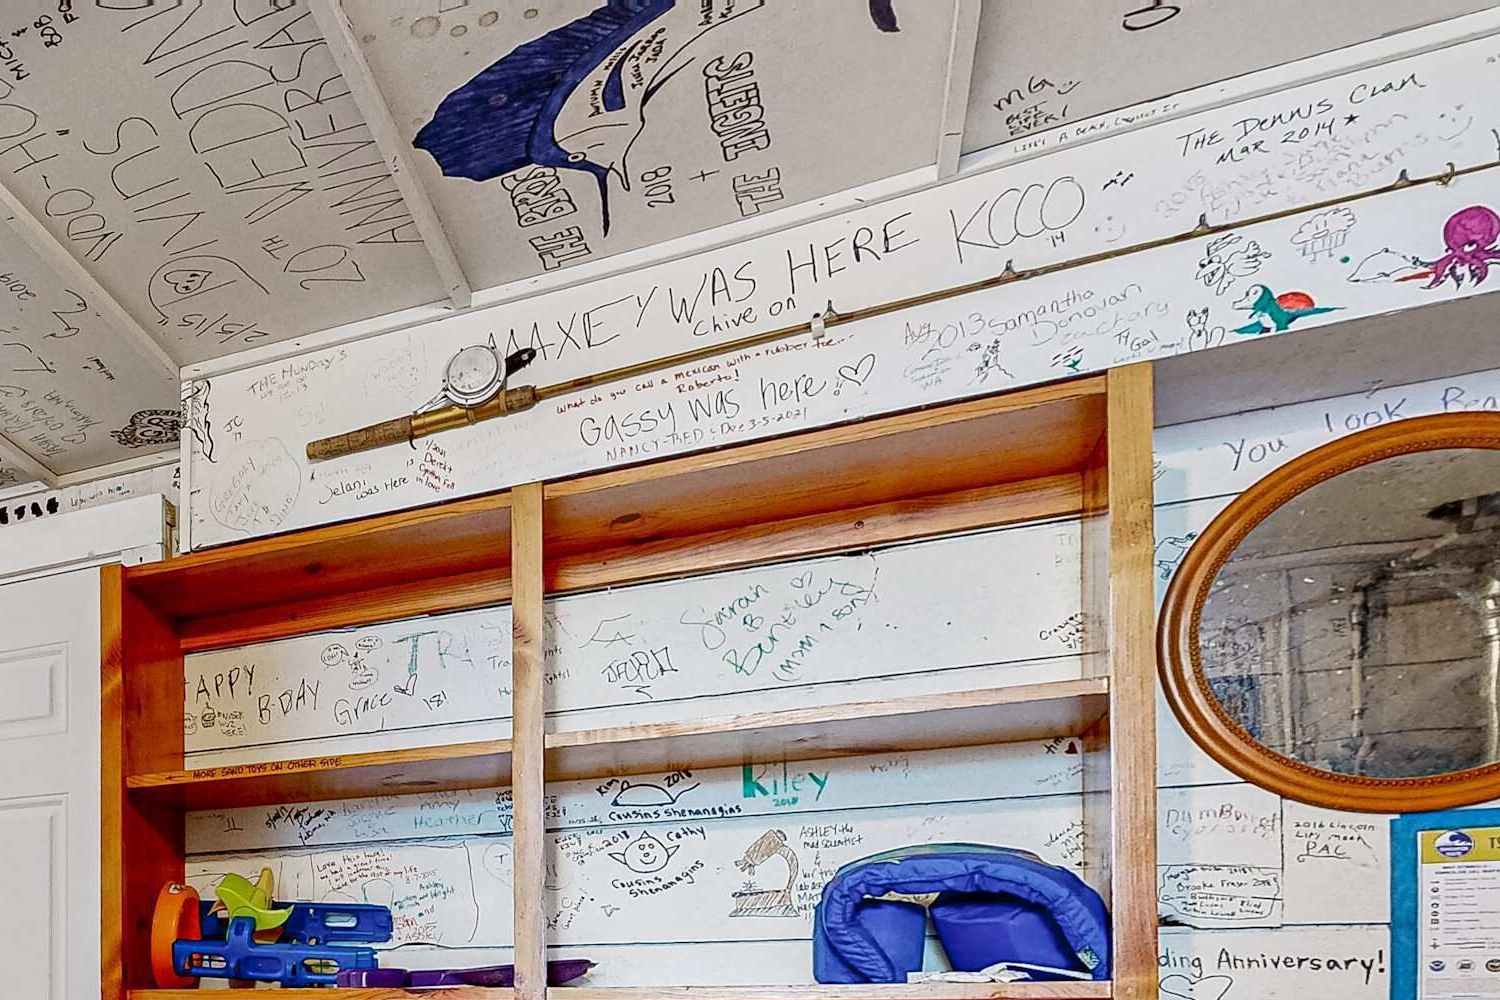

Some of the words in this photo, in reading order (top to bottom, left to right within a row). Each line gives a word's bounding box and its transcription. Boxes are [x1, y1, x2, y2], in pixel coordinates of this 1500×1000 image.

[1283, 118, 1336, 146] 2014
[641, 165, 673, 208] 2018
[732, 167, 784, 217] THE
[530, 226, 591, 271] THE
[669, 260, 757, 325] WAS
[787, 211, 922, 294] HERE
[947, 175, 1086, 267] KCCO
[1223, 436, 1287, 471] You
[184, 663, 257, 705] APPY
[257, 679, 322, 725] B-DAY
[193, 767, 219, 780] MORE
[220, 764, 244, 778] SAND
[245, 761, 269, 775] TOYS
[270, 759, 284, 772] ON
[286, 757, 318, 771] OTHER
[319, 756, 343, 769] SIDE
[1217, 948, 1387, 985] Anniversary!
